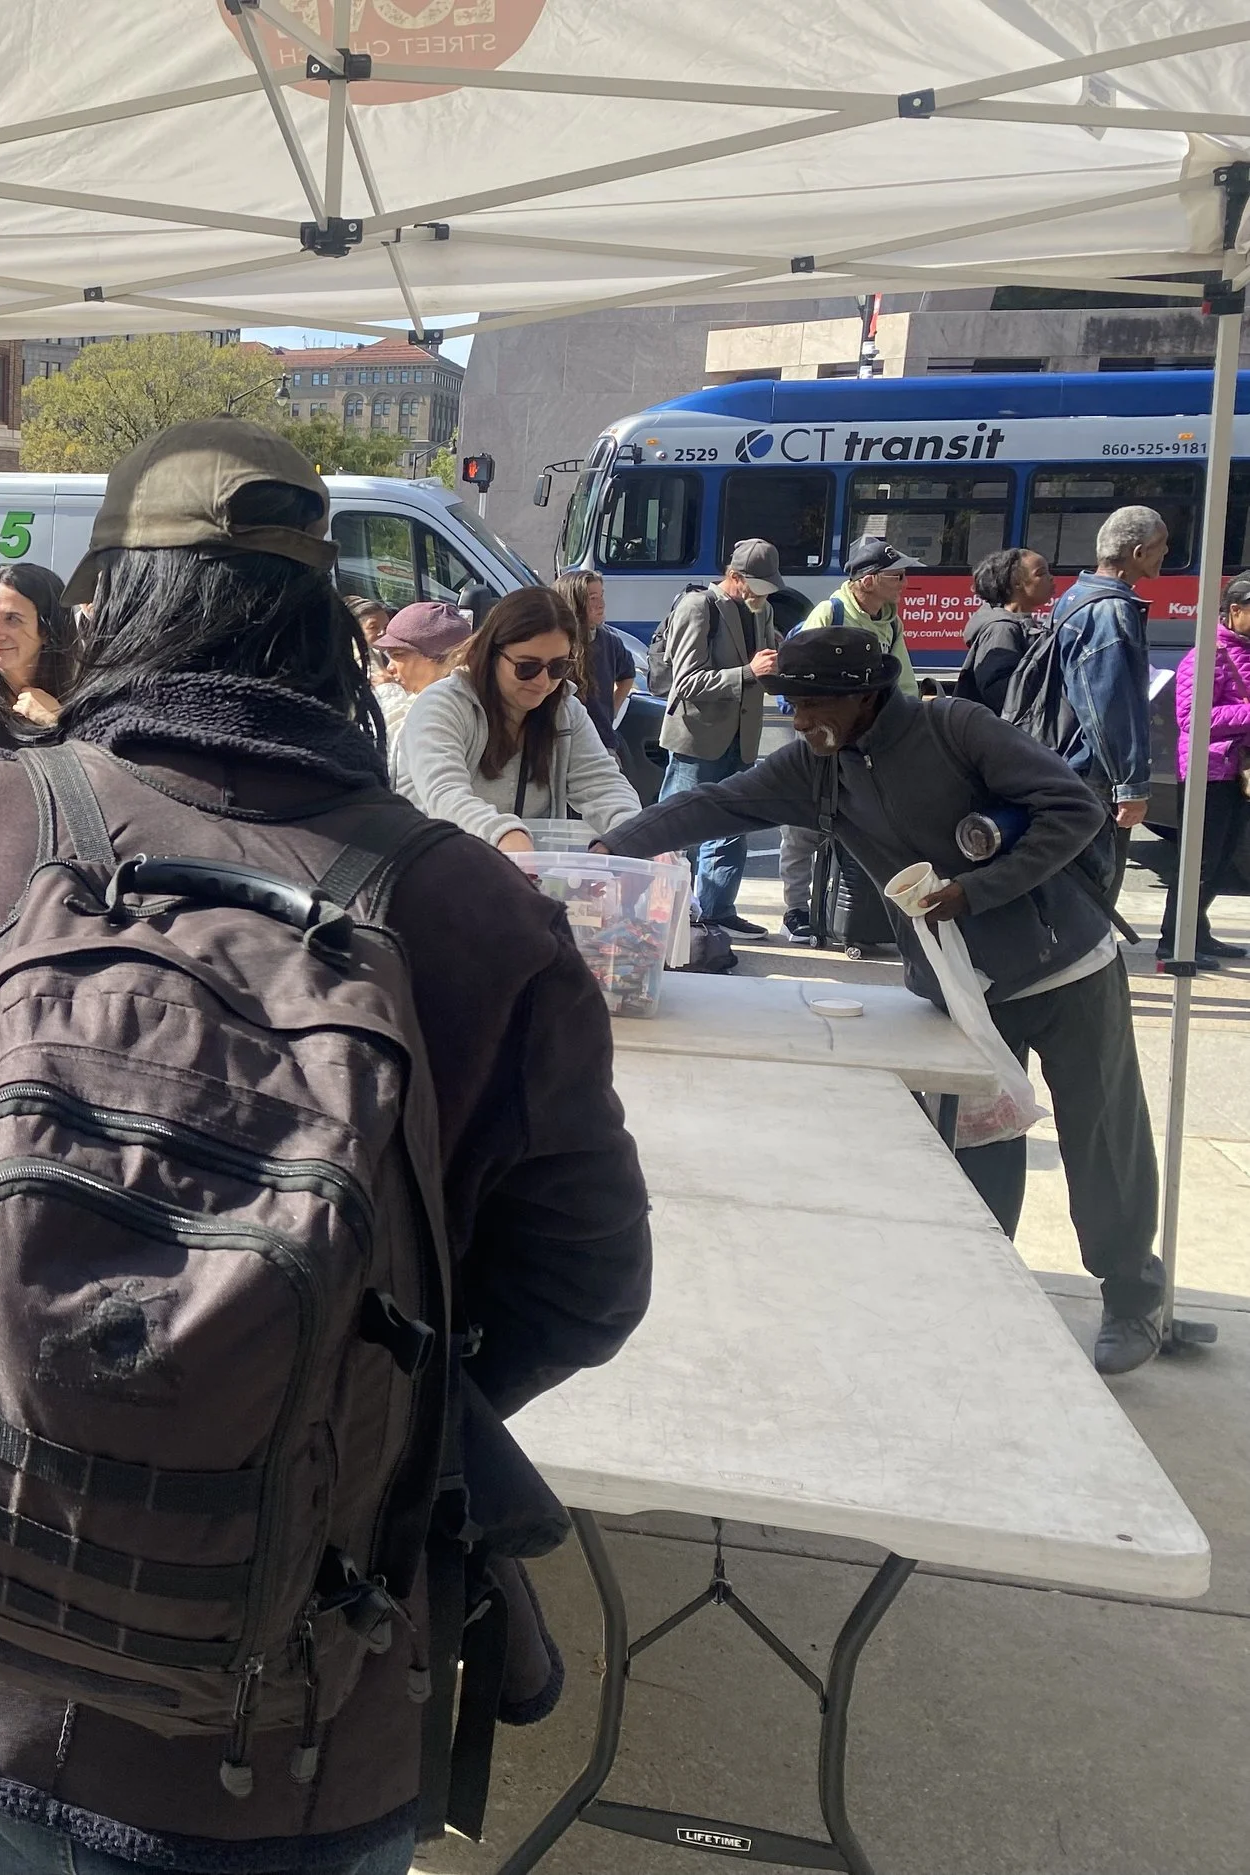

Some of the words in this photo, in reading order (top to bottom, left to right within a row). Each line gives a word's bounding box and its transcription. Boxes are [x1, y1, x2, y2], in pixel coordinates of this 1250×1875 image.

[780, 427, 835, 463] CT
[844, 422, 1006, 462] transit
[674, 448, 719, 462] 2529
[940, 596, 960, 609] go
[902, 608, 934, 623] help
[937, 611, 965, 623] you
[1168, 603, 1199, 617] Key
[685, 1831, 742, 1848] LIFETIME
